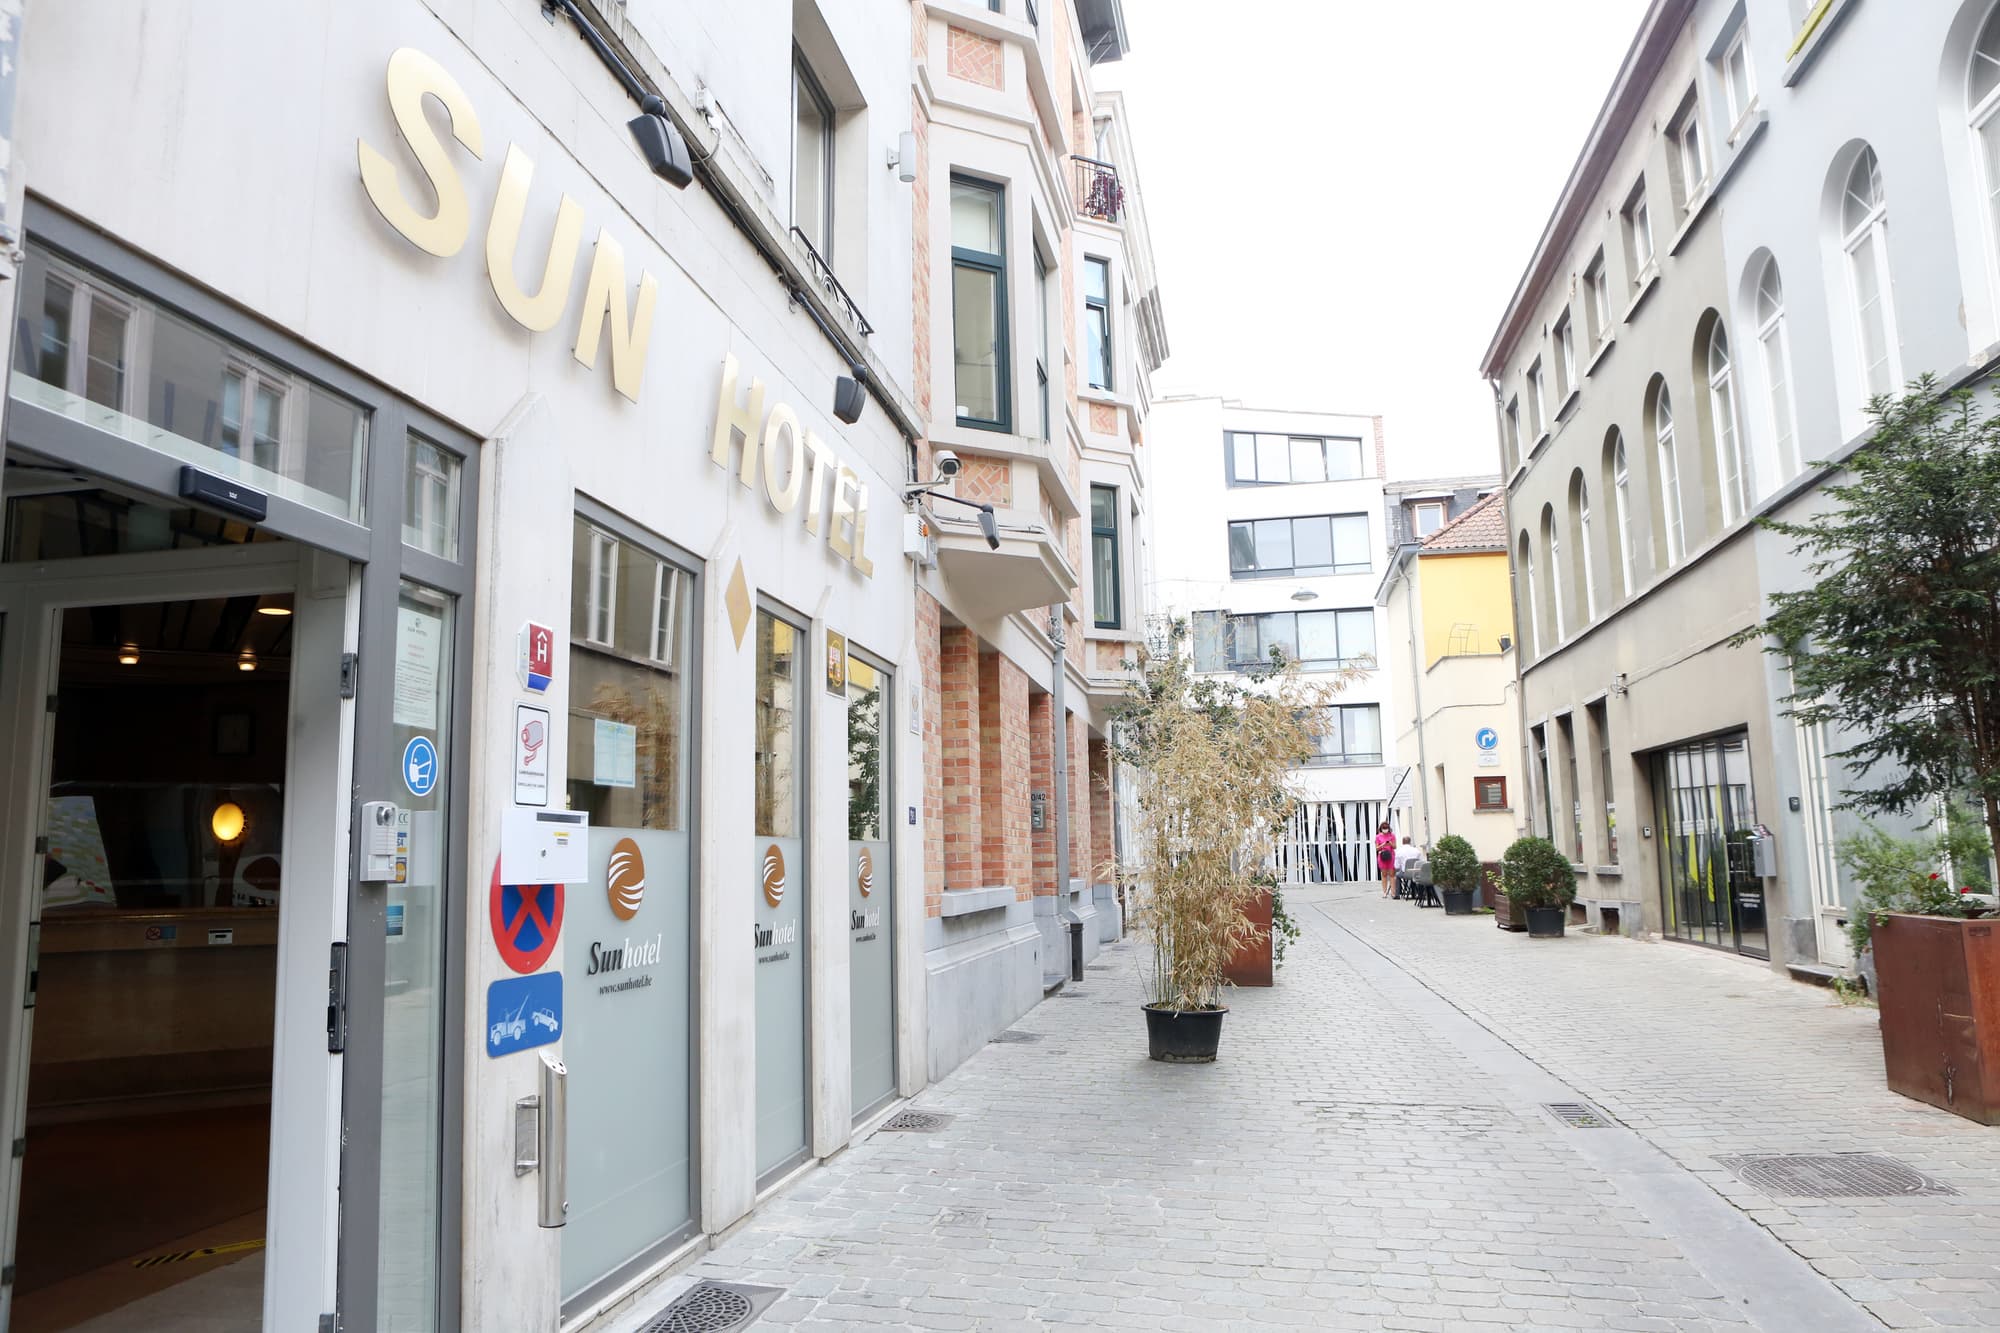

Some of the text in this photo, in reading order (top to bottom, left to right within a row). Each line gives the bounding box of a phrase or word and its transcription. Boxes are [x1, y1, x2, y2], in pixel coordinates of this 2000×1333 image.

[357, 46, 875, 579] SUN HOTEL
[851, 906, 880, 930] Sunhotel
[755, 919, 796, 949] Sunhotel
[587, 933, 662, 976] Sunhotel
[599, 974, 653, 996] www.sunhotel.be
